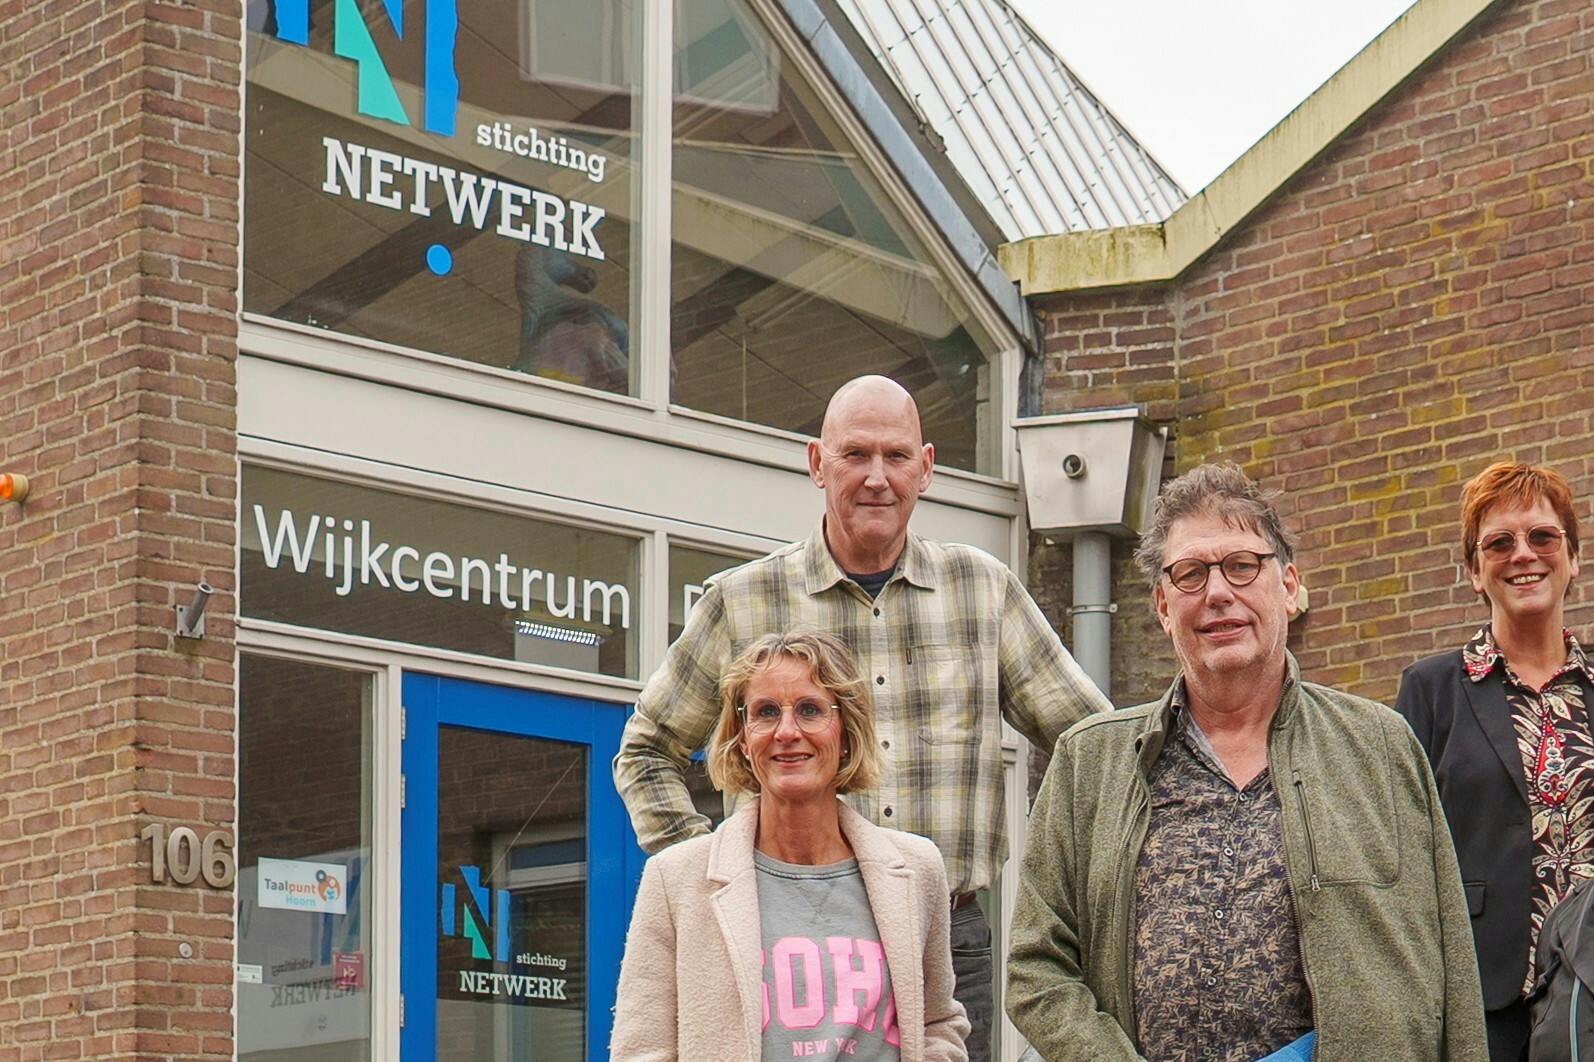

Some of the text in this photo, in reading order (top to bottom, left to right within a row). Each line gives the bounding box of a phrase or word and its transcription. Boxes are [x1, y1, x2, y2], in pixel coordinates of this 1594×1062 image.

[476, 121, 607, 183] stichting
[322, 136, 606, 260] NETWERK
[252, 504, 631, 630] Wijkcentrum
[140, 822, 235, 888] 106
[264, 878, 317, 894] Taalpunt
[515, 952, 567, 971] stichting
[459, 970, 567, 1000] NETWERK
[792, 1038, 829, 1057] NEW
